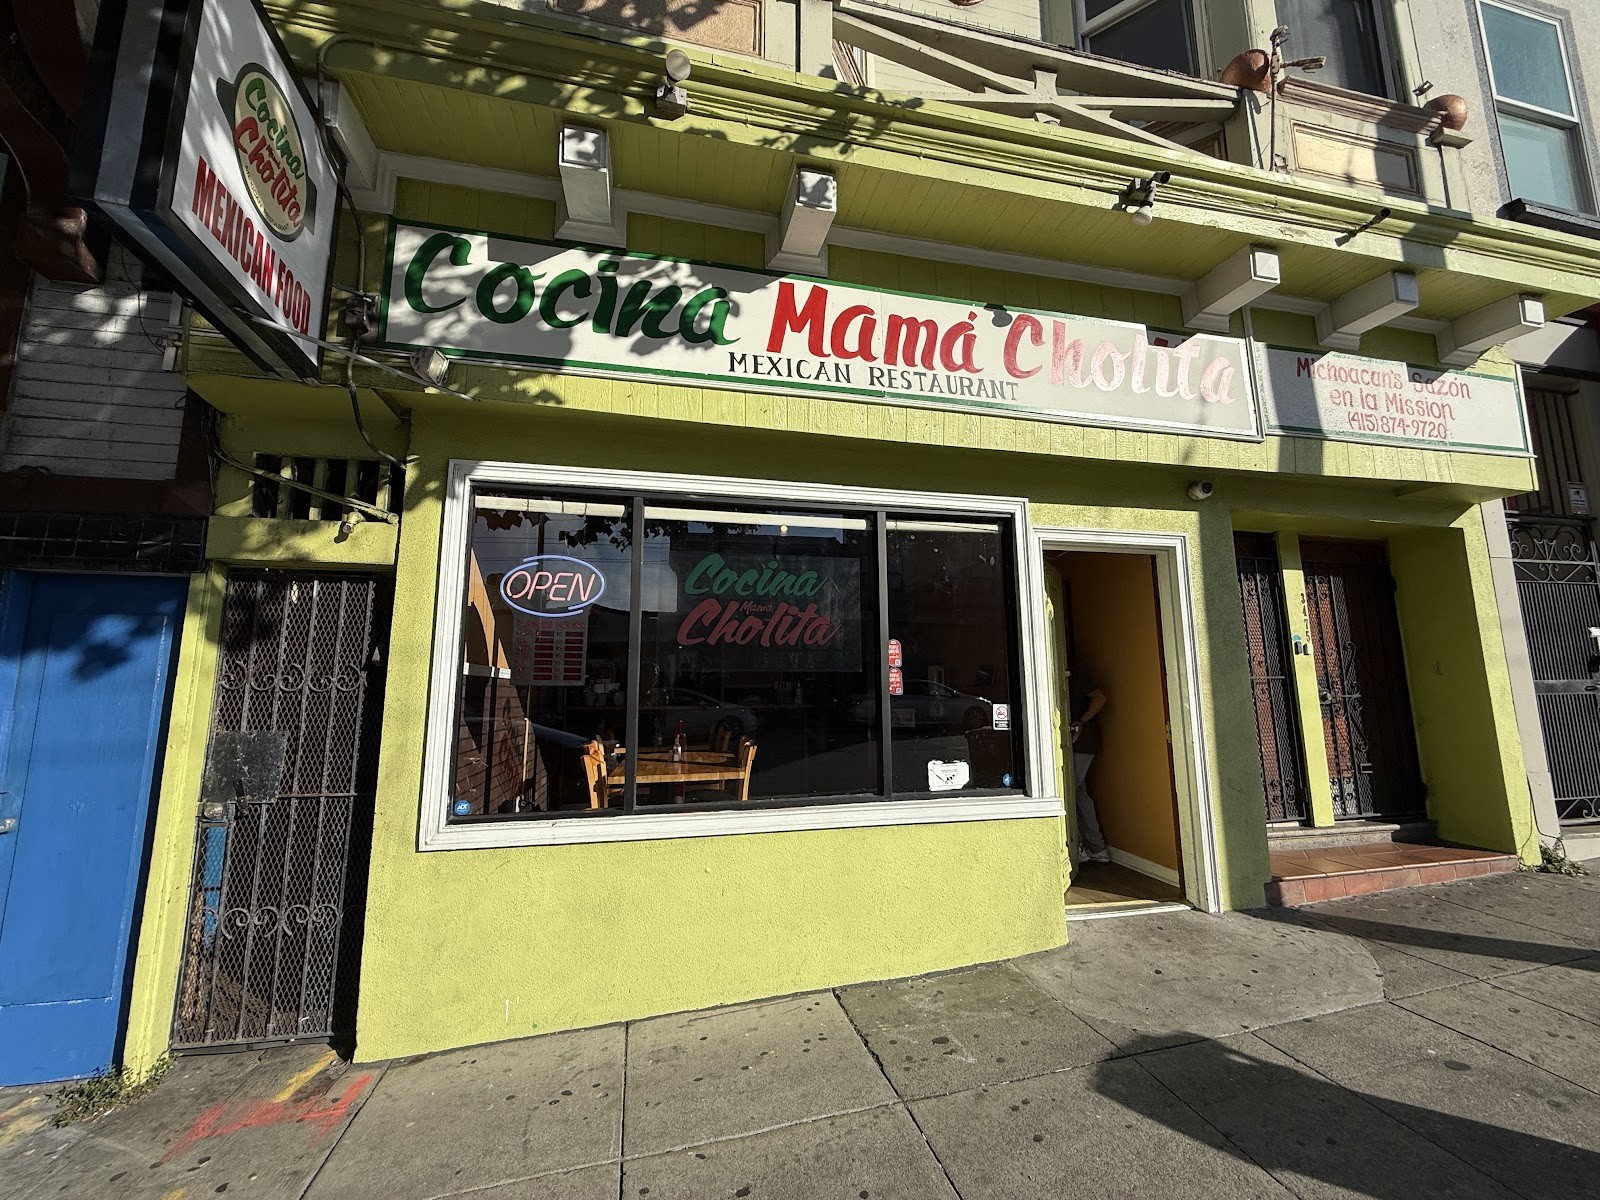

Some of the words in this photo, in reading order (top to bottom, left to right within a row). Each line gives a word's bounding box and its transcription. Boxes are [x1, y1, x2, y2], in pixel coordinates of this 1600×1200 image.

[245, 77, 305, 180] Cocina
[233, 116, 301, 227] Cholita
[192, 155, 275, 298] MEXICAN
[274, 258, 311, 335] FOOD
[404, 232, 741, 345] Cocina
[766, 281, 983, 374] Mamá
[1003, 313, 1239, 405] Cholita
[728, 351, 852, 384] MEXICAN
[868, 366, 1019, 401] RESTAURANT
[1296, 357, 1403, 390] Michoacan's
[1329, 388, 1354, 408] en
[1359, 387, 1378, 411] la
[1385, 391, 1455, 420] Mission
[506, 570, 595, 601] OPEN
[684, 553, 828, 597] Cocina
[676, 597, 842, 647] Cholita
